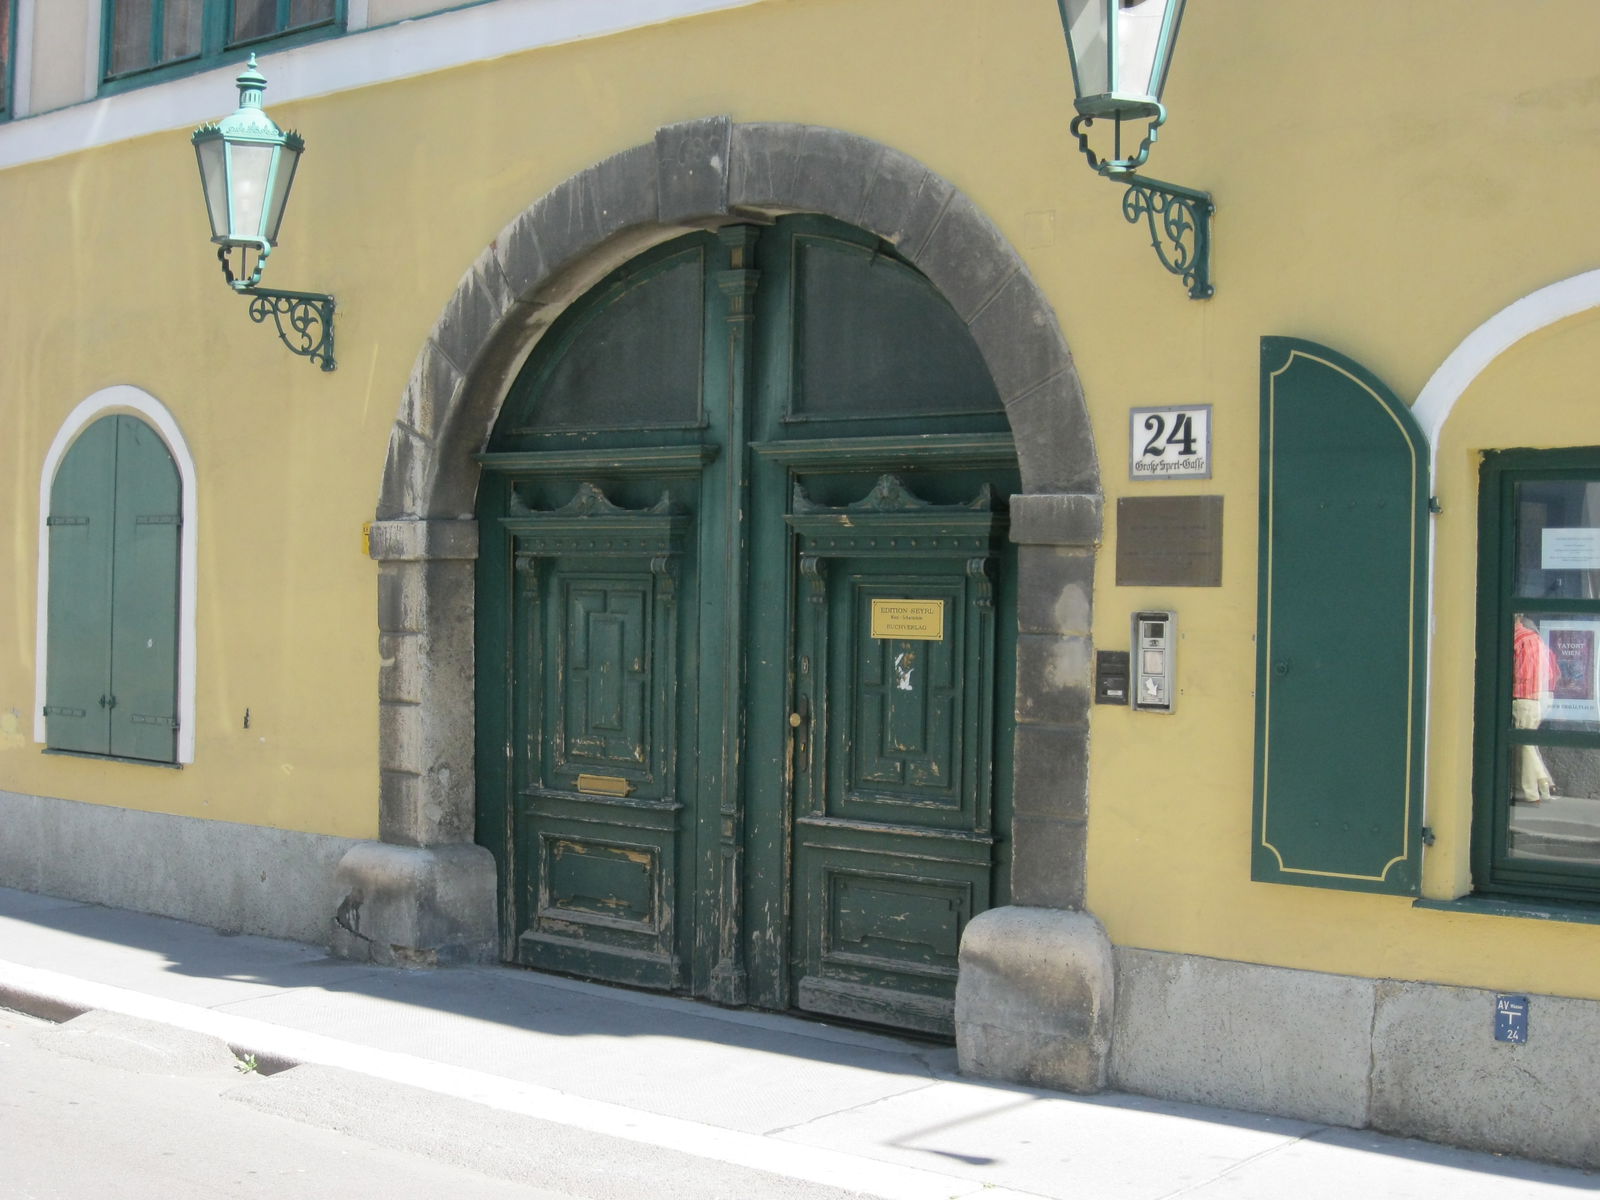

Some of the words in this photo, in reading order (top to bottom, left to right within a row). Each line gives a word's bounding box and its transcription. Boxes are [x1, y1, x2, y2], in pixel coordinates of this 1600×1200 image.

[1143, 413, 1197, 456] 24
[1497, 1000, 1509, 1010] AV
[1506, 1029, 1519, 1040] 24
